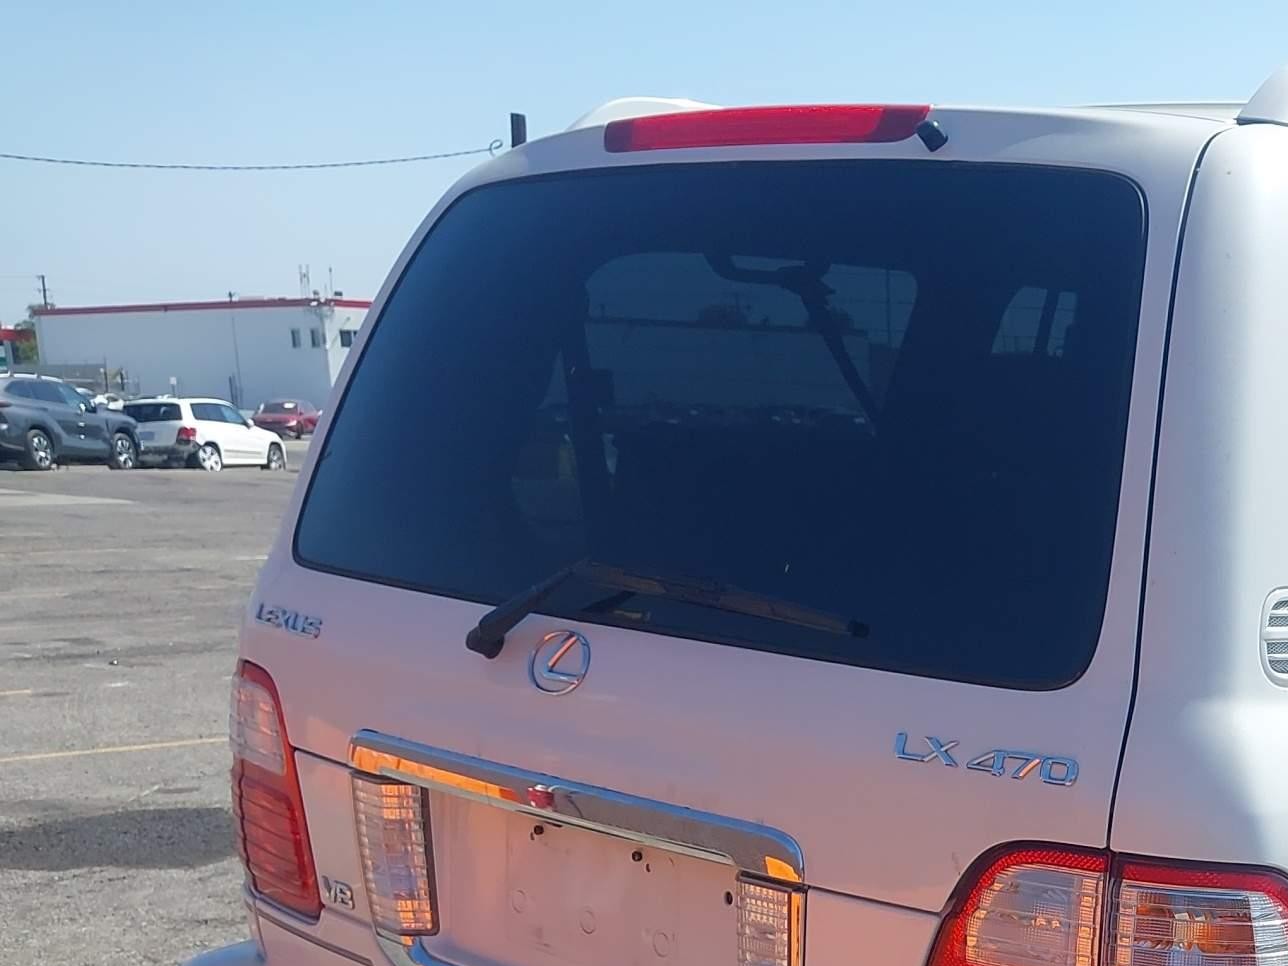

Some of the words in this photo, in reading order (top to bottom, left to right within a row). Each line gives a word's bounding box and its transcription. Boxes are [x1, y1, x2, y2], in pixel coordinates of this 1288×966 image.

[256, 603, 323, 639] LEXUS
[895, 731, 959, 768] LX
[966, 748, 1080, 787] 470
